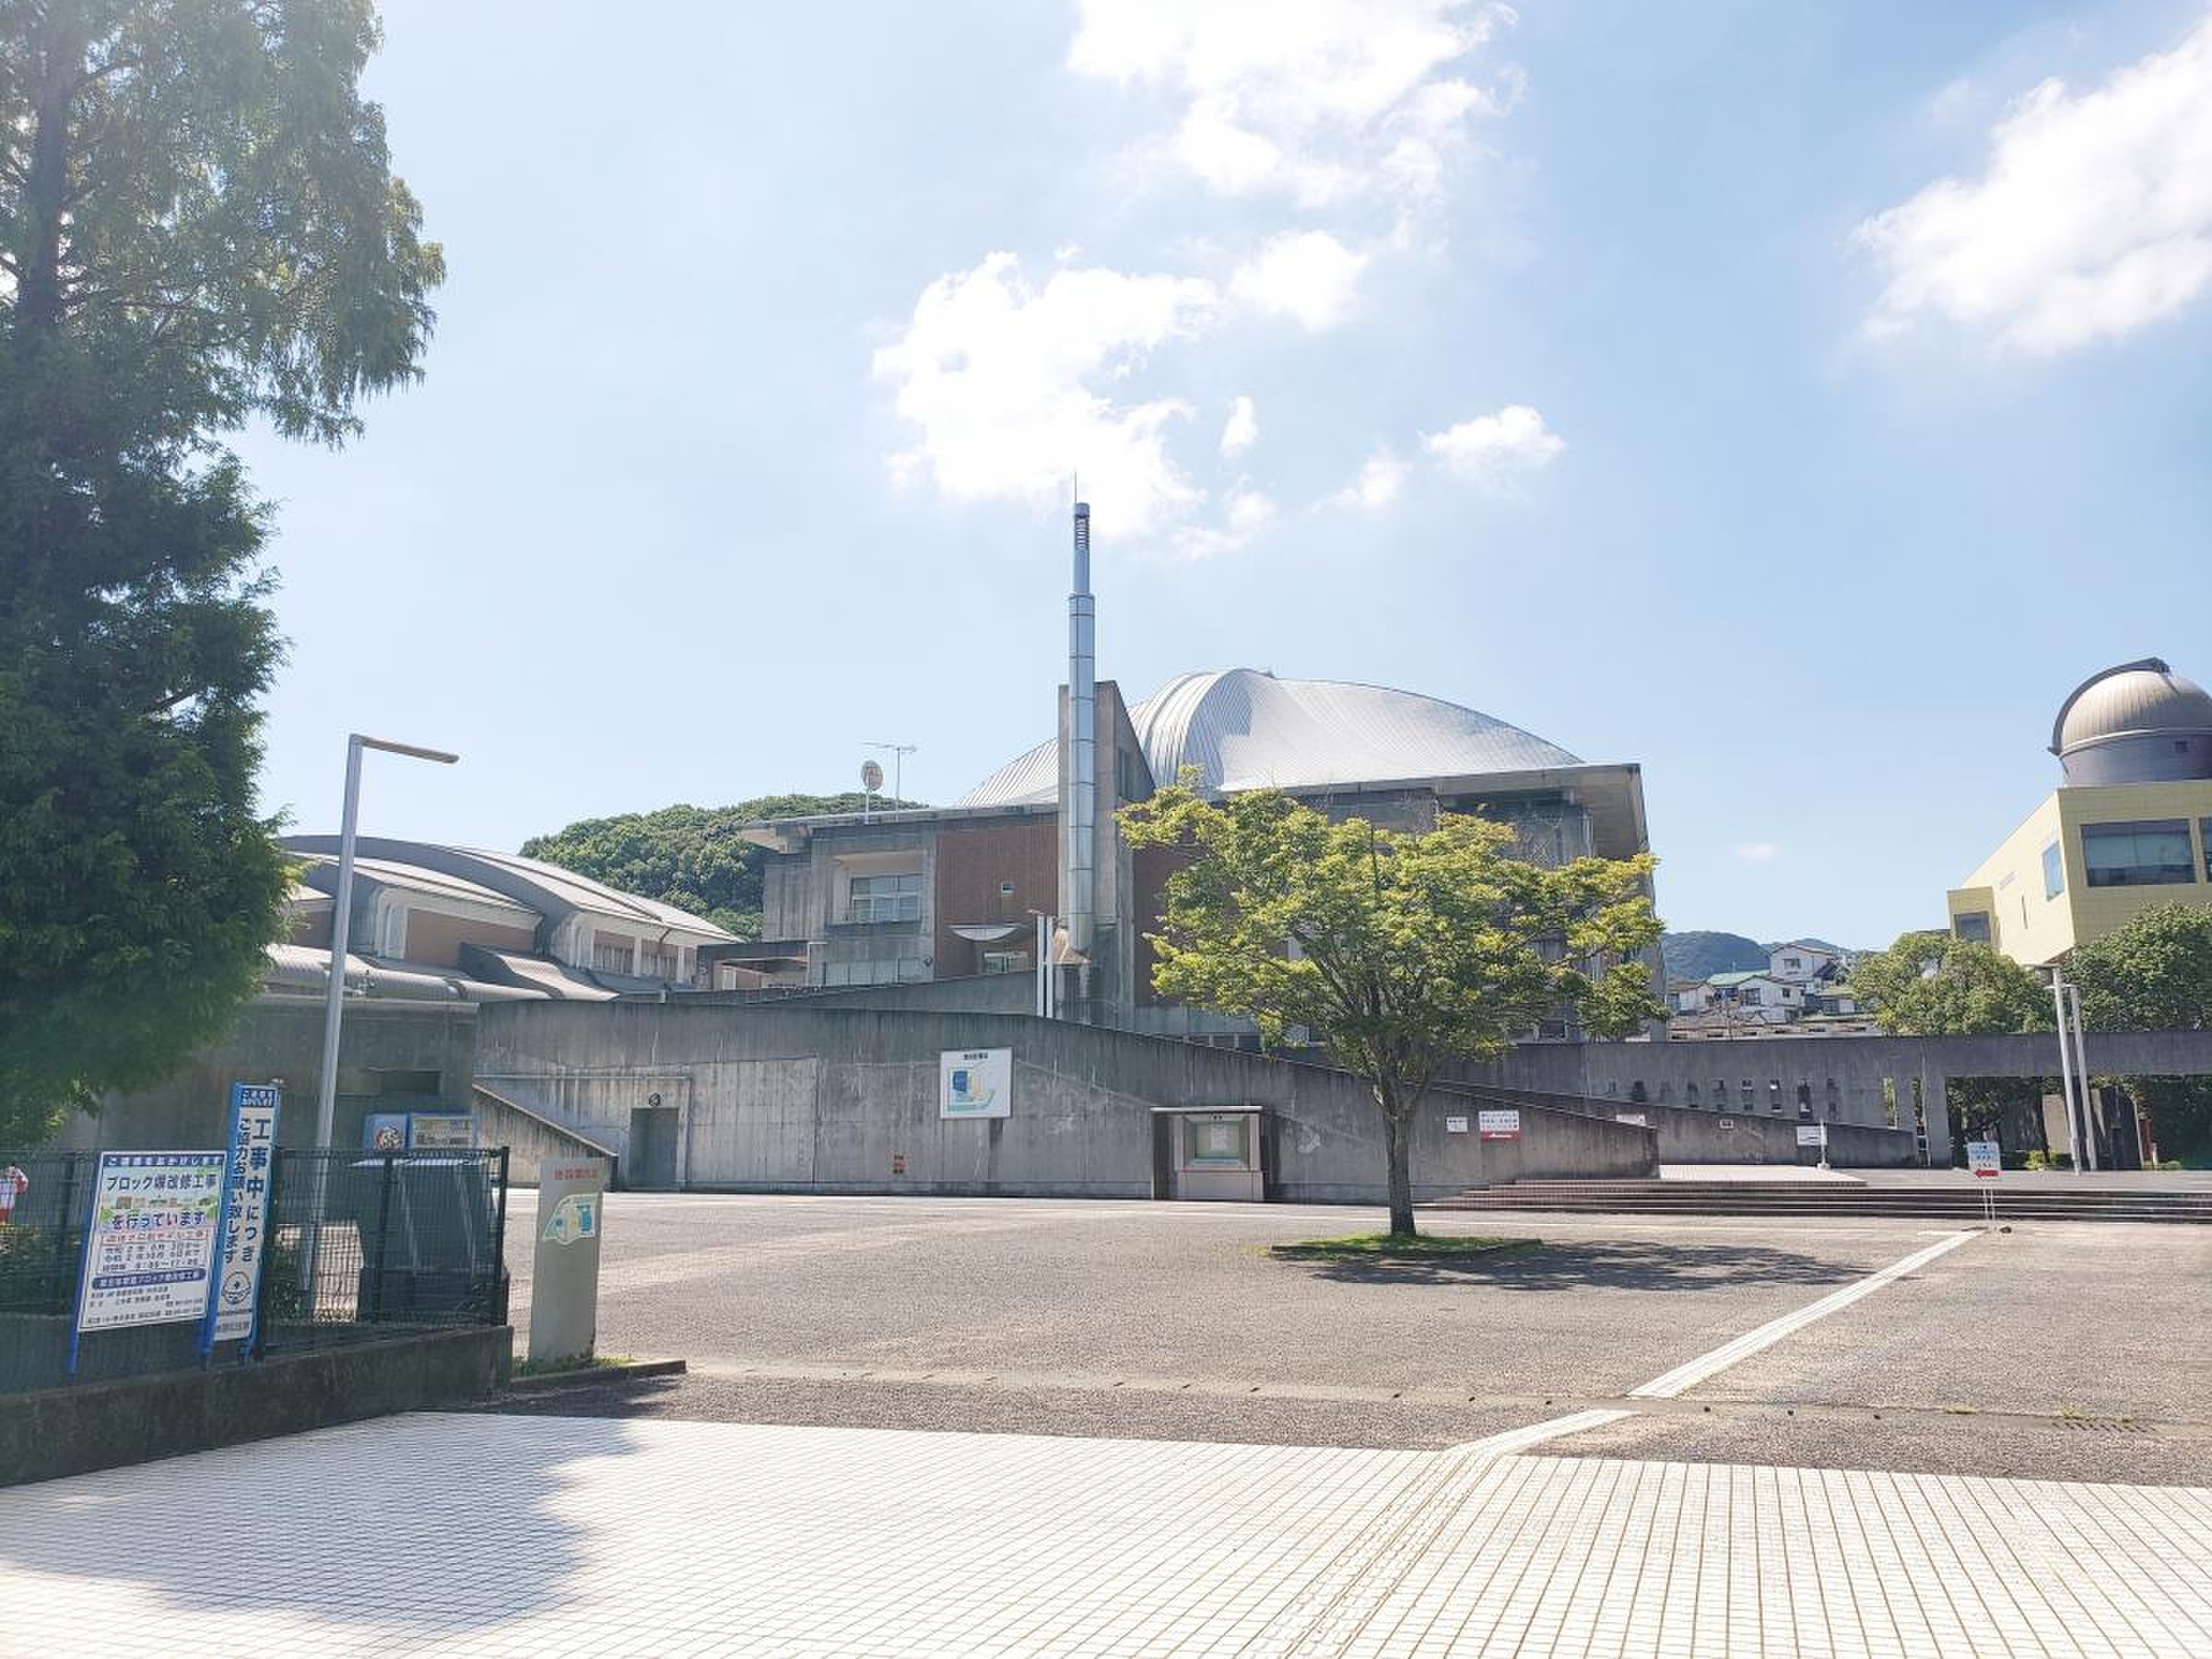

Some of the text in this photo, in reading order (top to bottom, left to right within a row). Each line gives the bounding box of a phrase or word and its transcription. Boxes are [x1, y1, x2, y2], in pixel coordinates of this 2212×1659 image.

[112, 1211, 206, 1230] を行っています
[241, 1118, 271, 1263] 工事中につき
